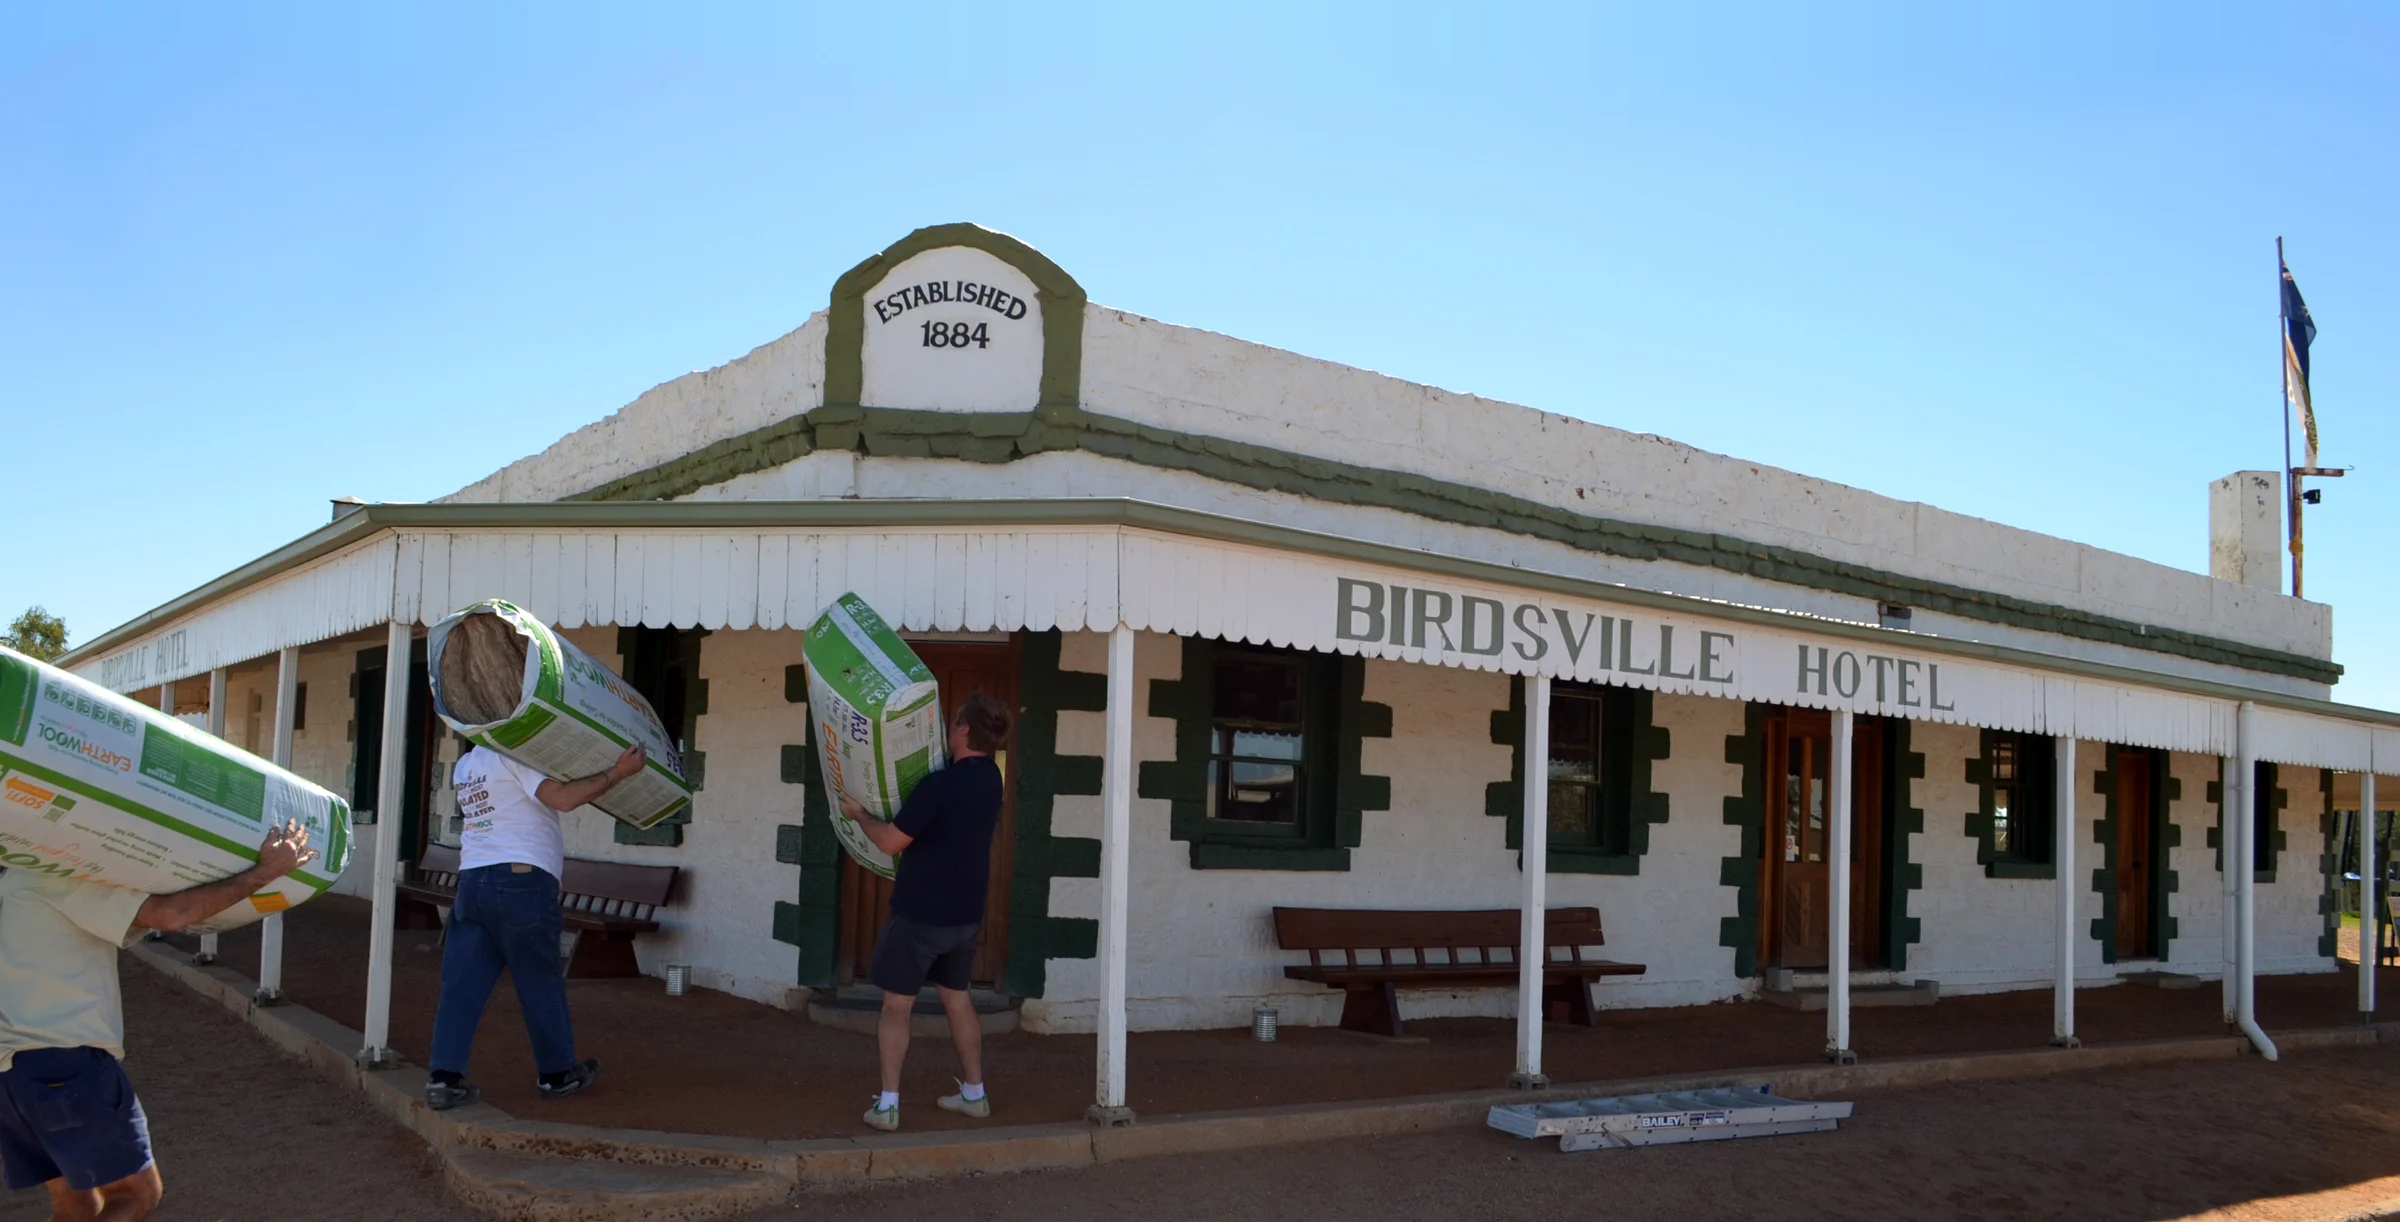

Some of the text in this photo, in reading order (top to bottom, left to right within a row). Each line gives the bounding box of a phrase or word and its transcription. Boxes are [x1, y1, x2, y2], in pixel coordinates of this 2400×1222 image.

[873, 281, 1027, 324] ESTABLISHED
[921, 320, 990, 349] 1884
[155, 629, 188, 675] HOTEL
[1336, 577, 1955, 712] BIRDSVILLE HOTEL
[38, 723, 131, 771] EARTHWOOL
[851, 710, 868, 746] R-3.5
[3, 789, 45, 811] SOFT!
[1642, 1115, 1680, 1127] BAILEY
